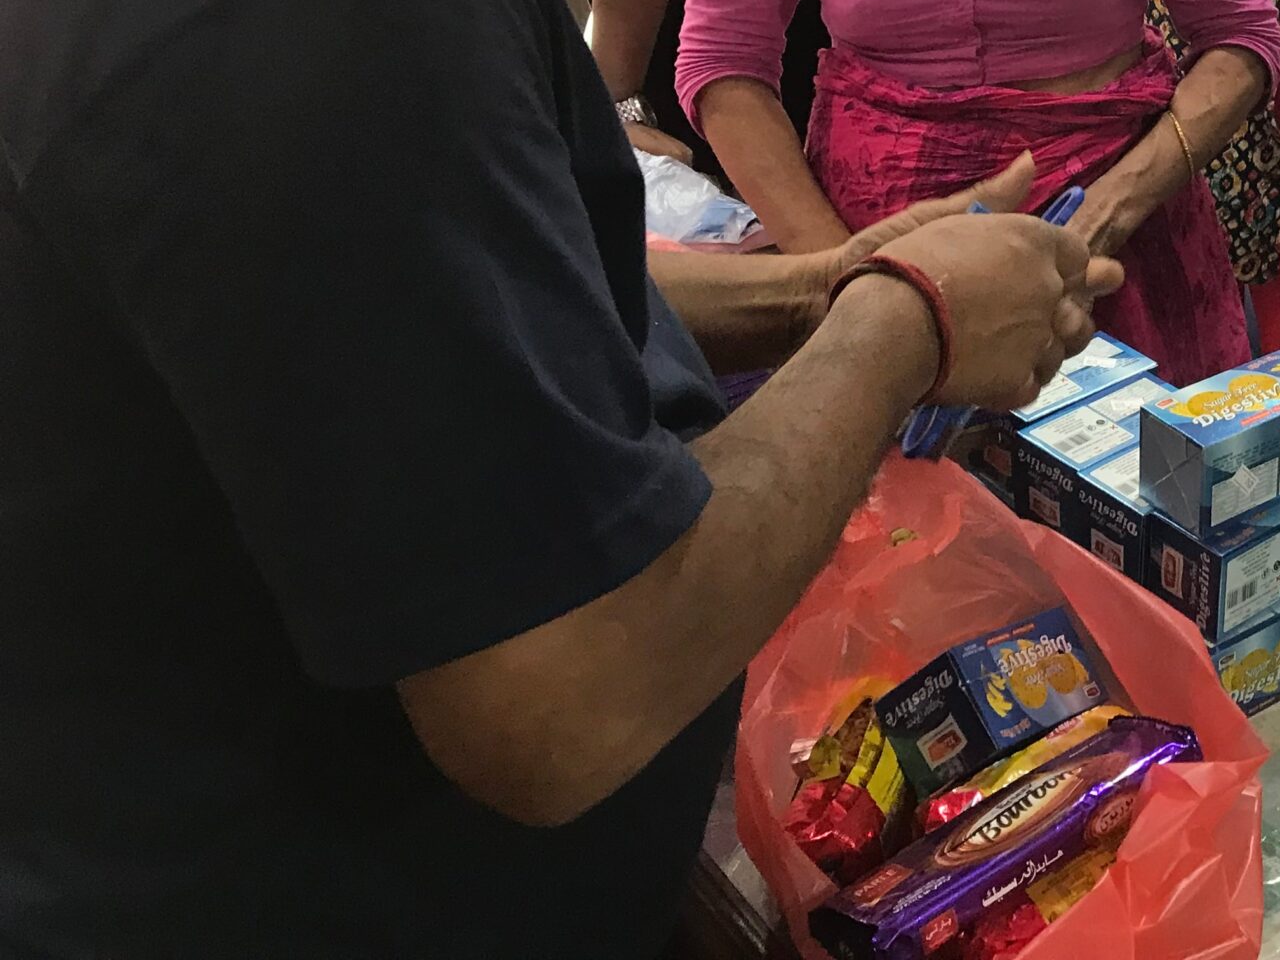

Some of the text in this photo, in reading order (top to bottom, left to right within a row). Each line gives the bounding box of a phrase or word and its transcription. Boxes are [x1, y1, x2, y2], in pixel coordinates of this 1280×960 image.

[1016, 447, 1073, 491] Digestive
[1078, 489, 1139, 537] Digestive
[1195, 551, 1212, 630] Digestive
[997, 633, 1073, 677] Digestive
[885, 668, 954, 728] Digestive
[977, 769, 1080, 843] Bourbon
